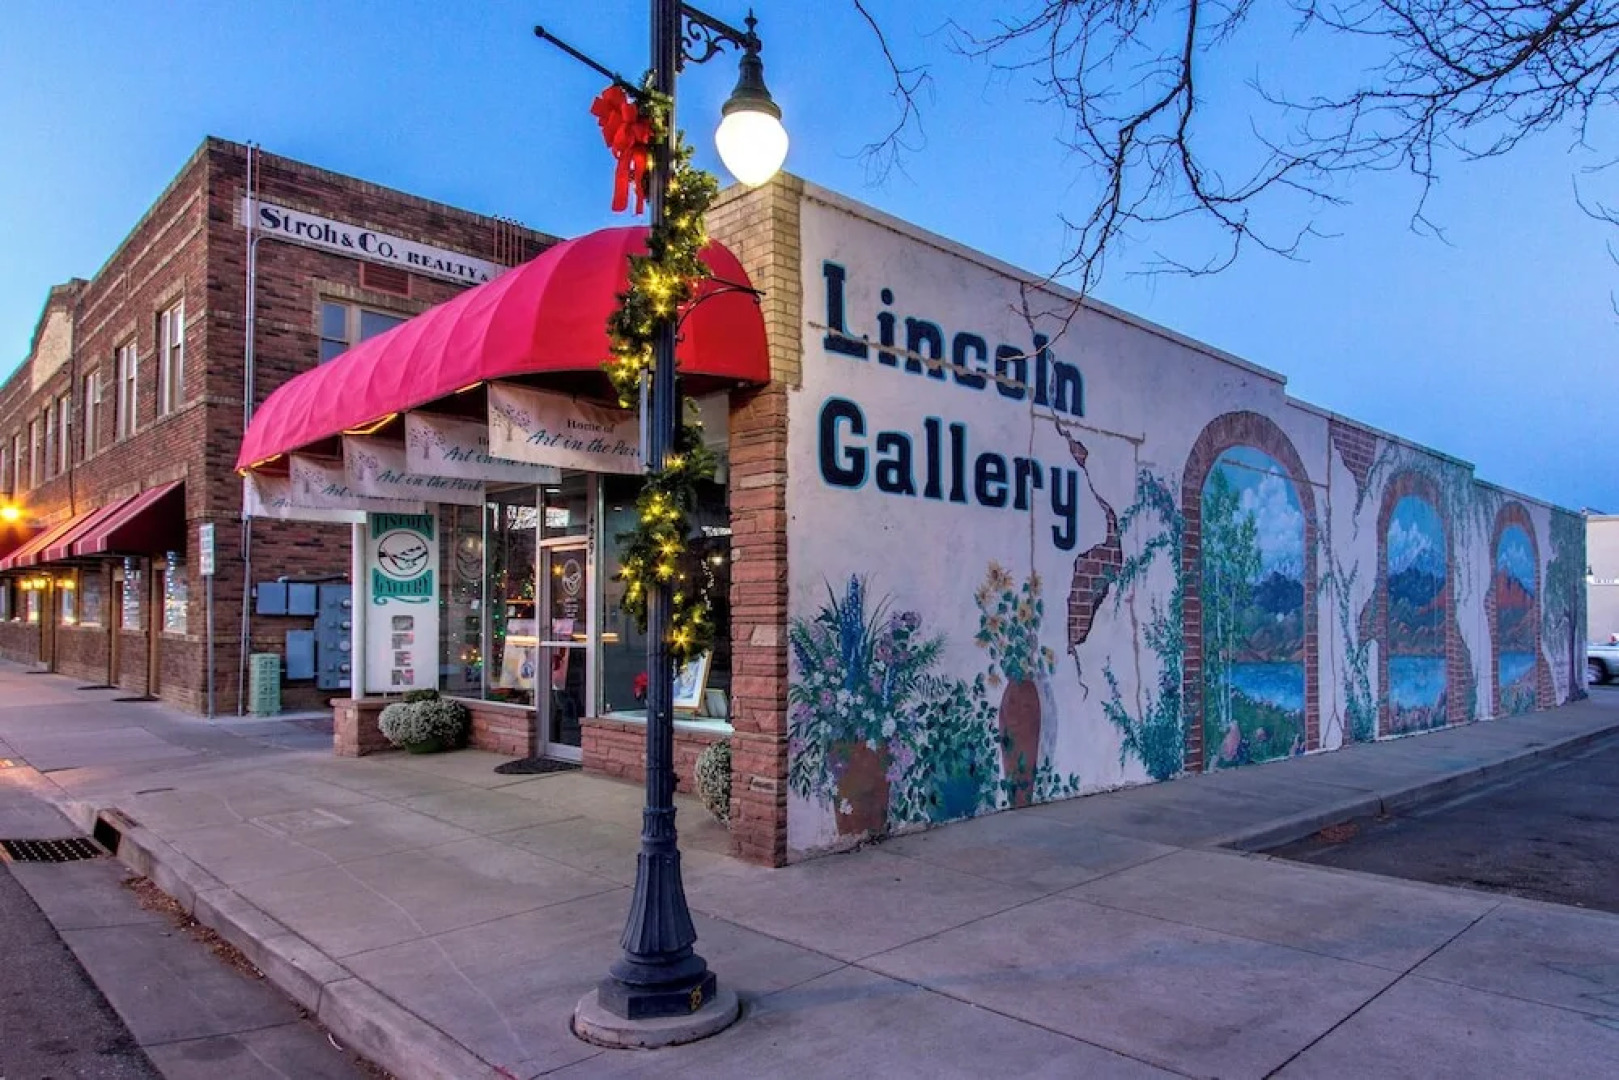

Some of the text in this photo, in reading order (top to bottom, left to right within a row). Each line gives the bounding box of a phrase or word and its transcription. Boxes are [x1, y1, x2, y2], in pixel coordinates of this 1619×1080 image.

[260, 207, 337, 244] Stroh
[341, 232, 354, 248] &
[358, 232, 398, 259] Co.
[407, 251, 478, 278] REALTY
[822, 259, 1086, 417] Lincoln
[567, 418, 615, 433] Home of
[526, 428, 562, 448] Art
[564, 435, 583, 450] in
[587, 436, 611, 454] the
[443, 446, 474, 463] Art
[376, 469, 484, 492] Art in the Park
[817, 396, 1078, 550] Gallery
[321, 483, 349, 497] Art
[391, 614, 414, 686] OPEN
